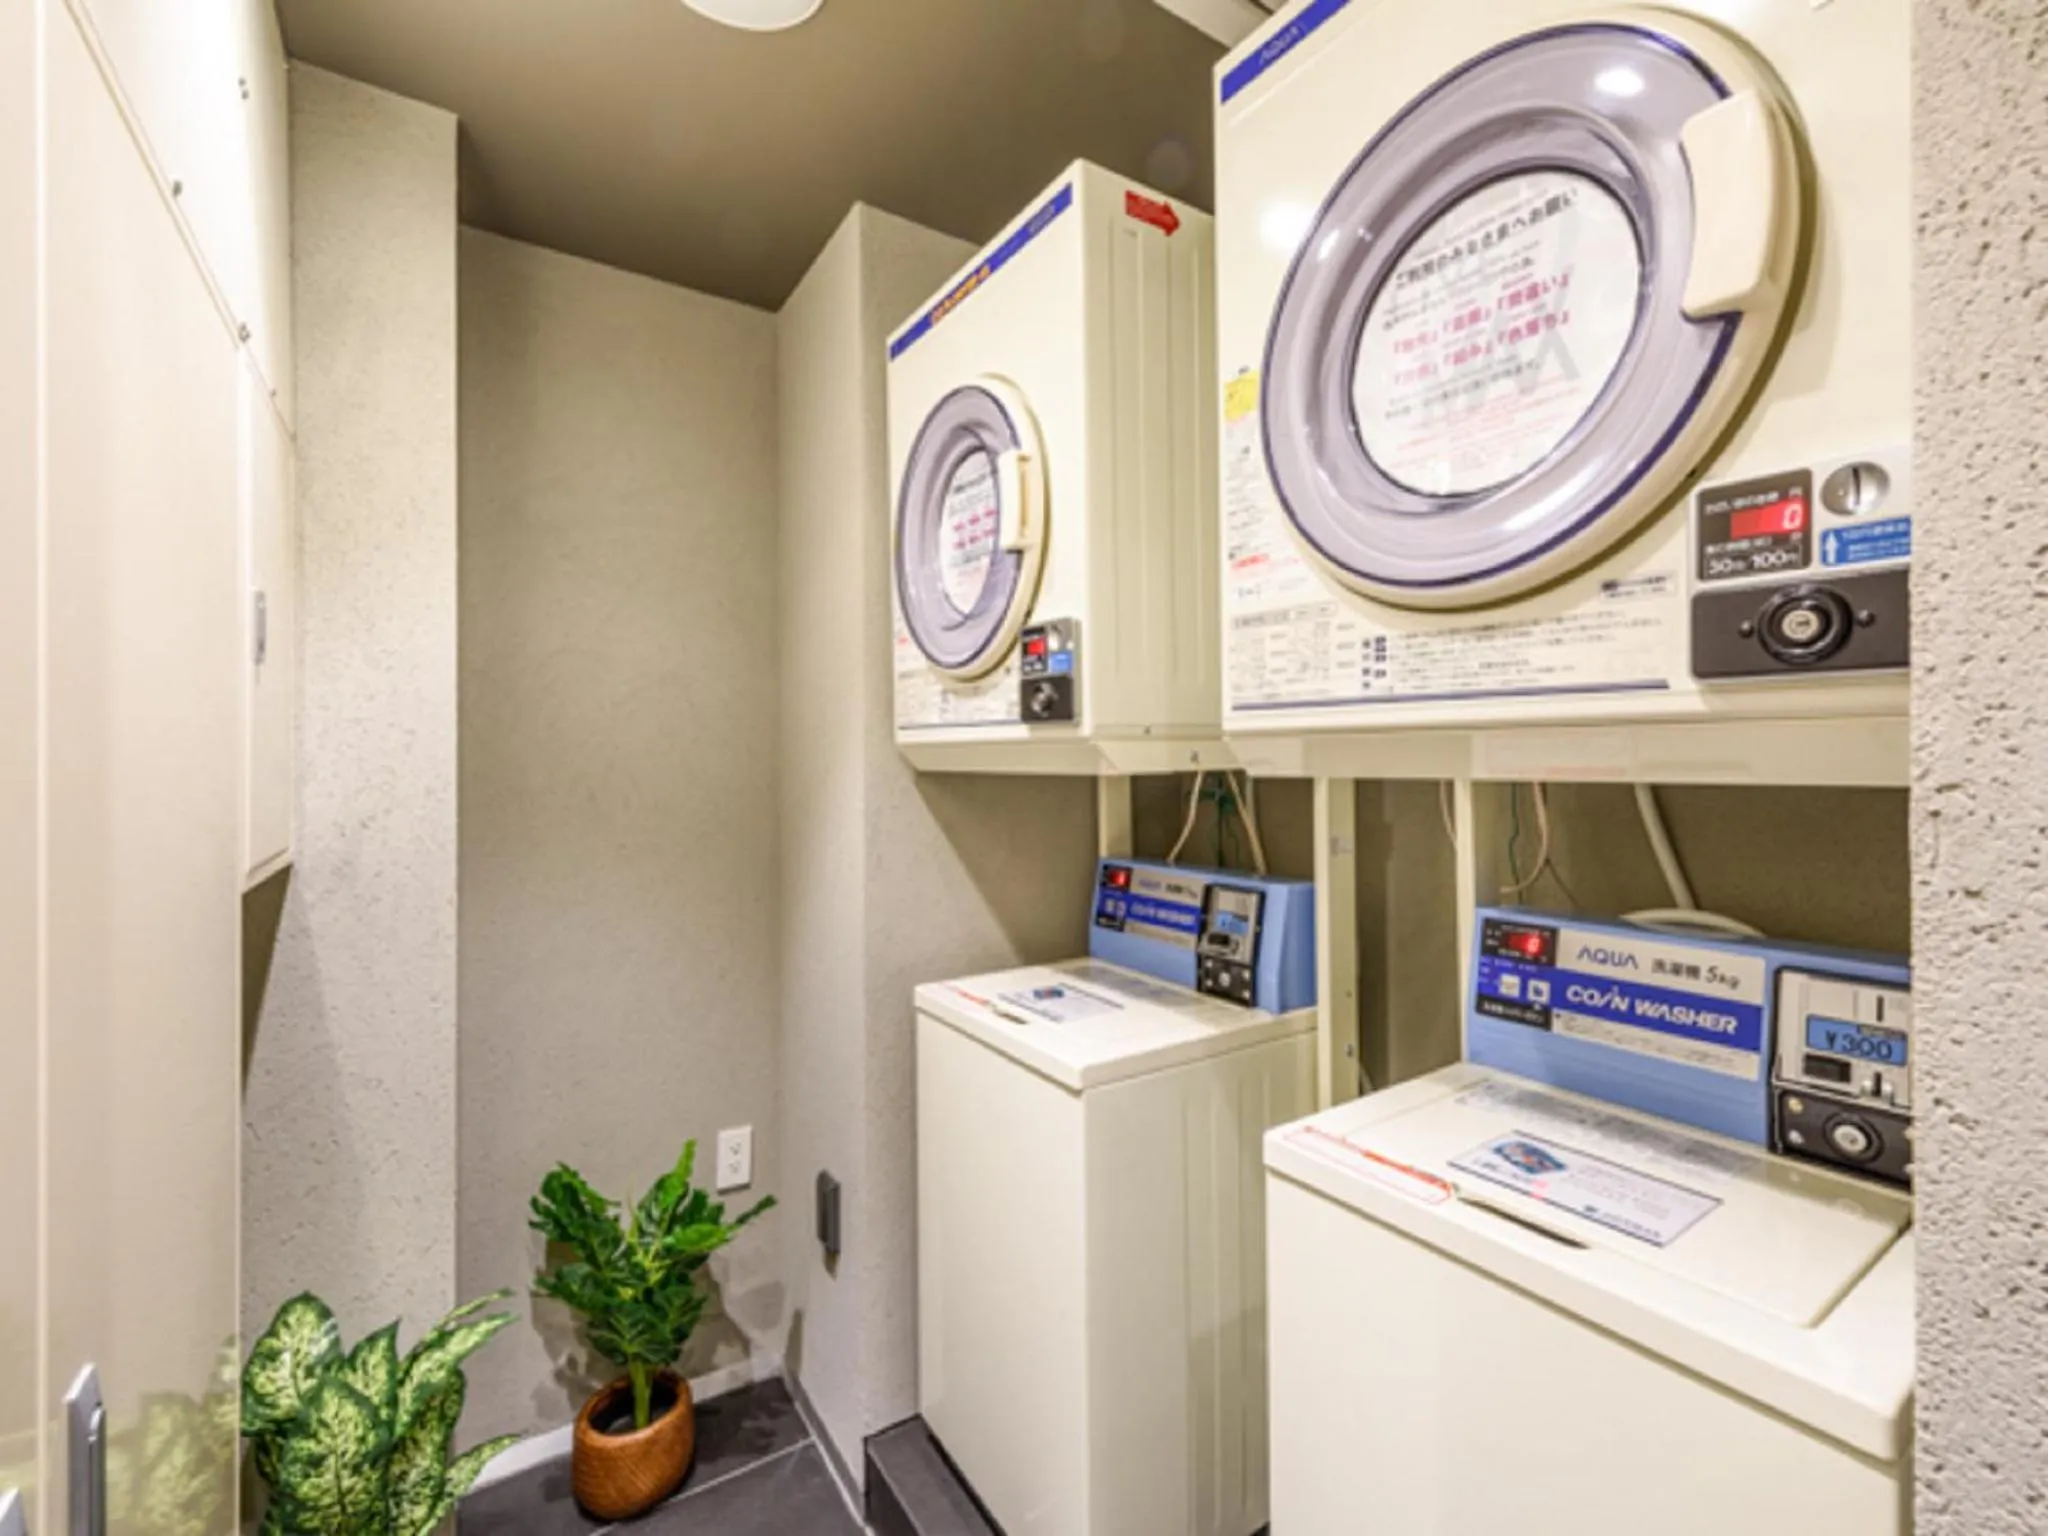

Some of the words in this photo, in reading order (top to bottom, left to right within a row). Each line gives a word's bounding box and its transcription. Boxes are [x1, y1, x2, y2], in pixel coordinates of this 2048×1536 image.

[1782, 502, 1804, 531] 0
[1576, 944, 1640, 970] AQUA
[1650, 957, 1702, 981] 洗濯機
[1704, 965, 1742, 991] 5kg
[1633, 998, 1740, 1035] WASHER
